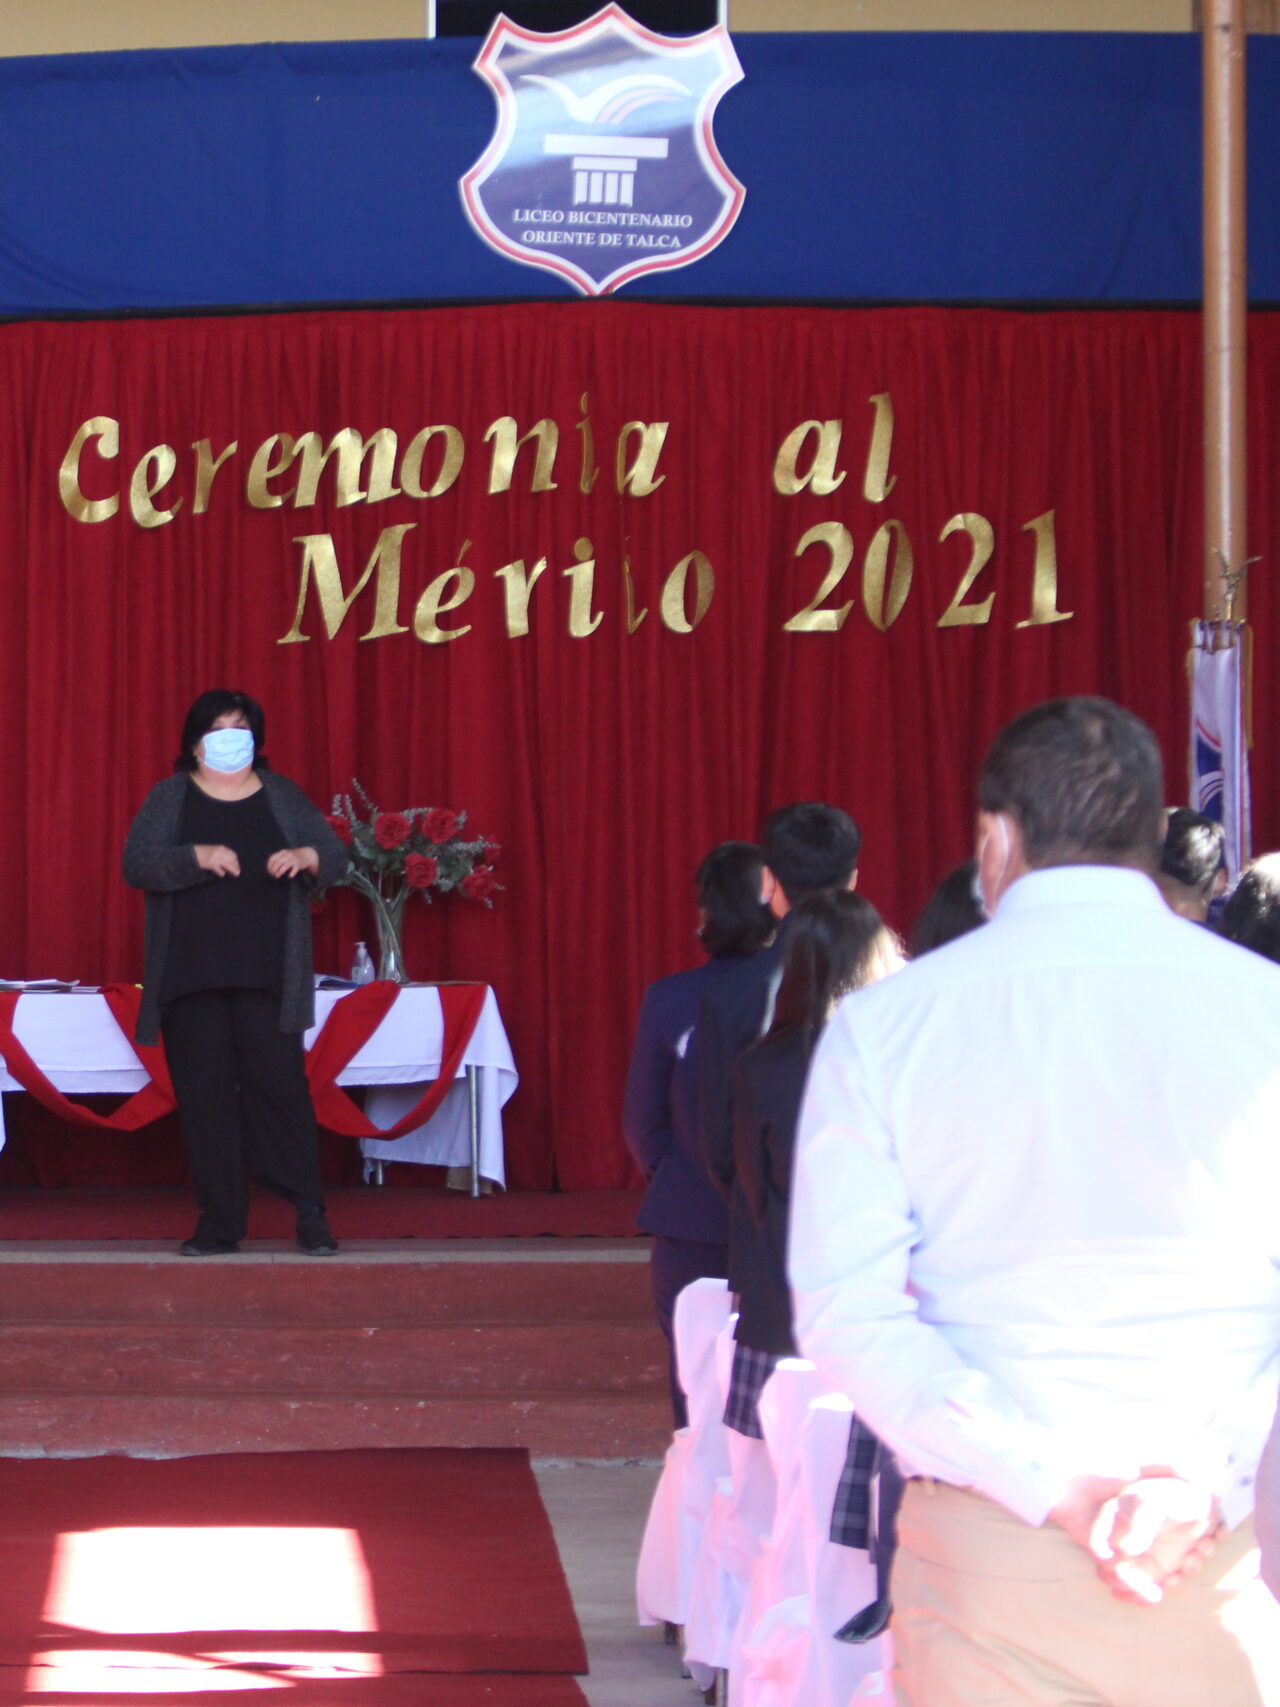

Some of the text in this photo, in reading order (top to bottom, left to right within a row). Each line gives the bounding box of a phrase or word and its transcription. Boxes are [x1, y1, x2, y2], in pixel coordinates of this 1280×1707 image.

[513, 208, 694, 228] LICEO BICENTENARIO
[523, 230, 683, 249] ORIENTE DE TALCA
[58, 391, 897, 528] Ceremonia al
[782, 509, 1074, 632] 2021
